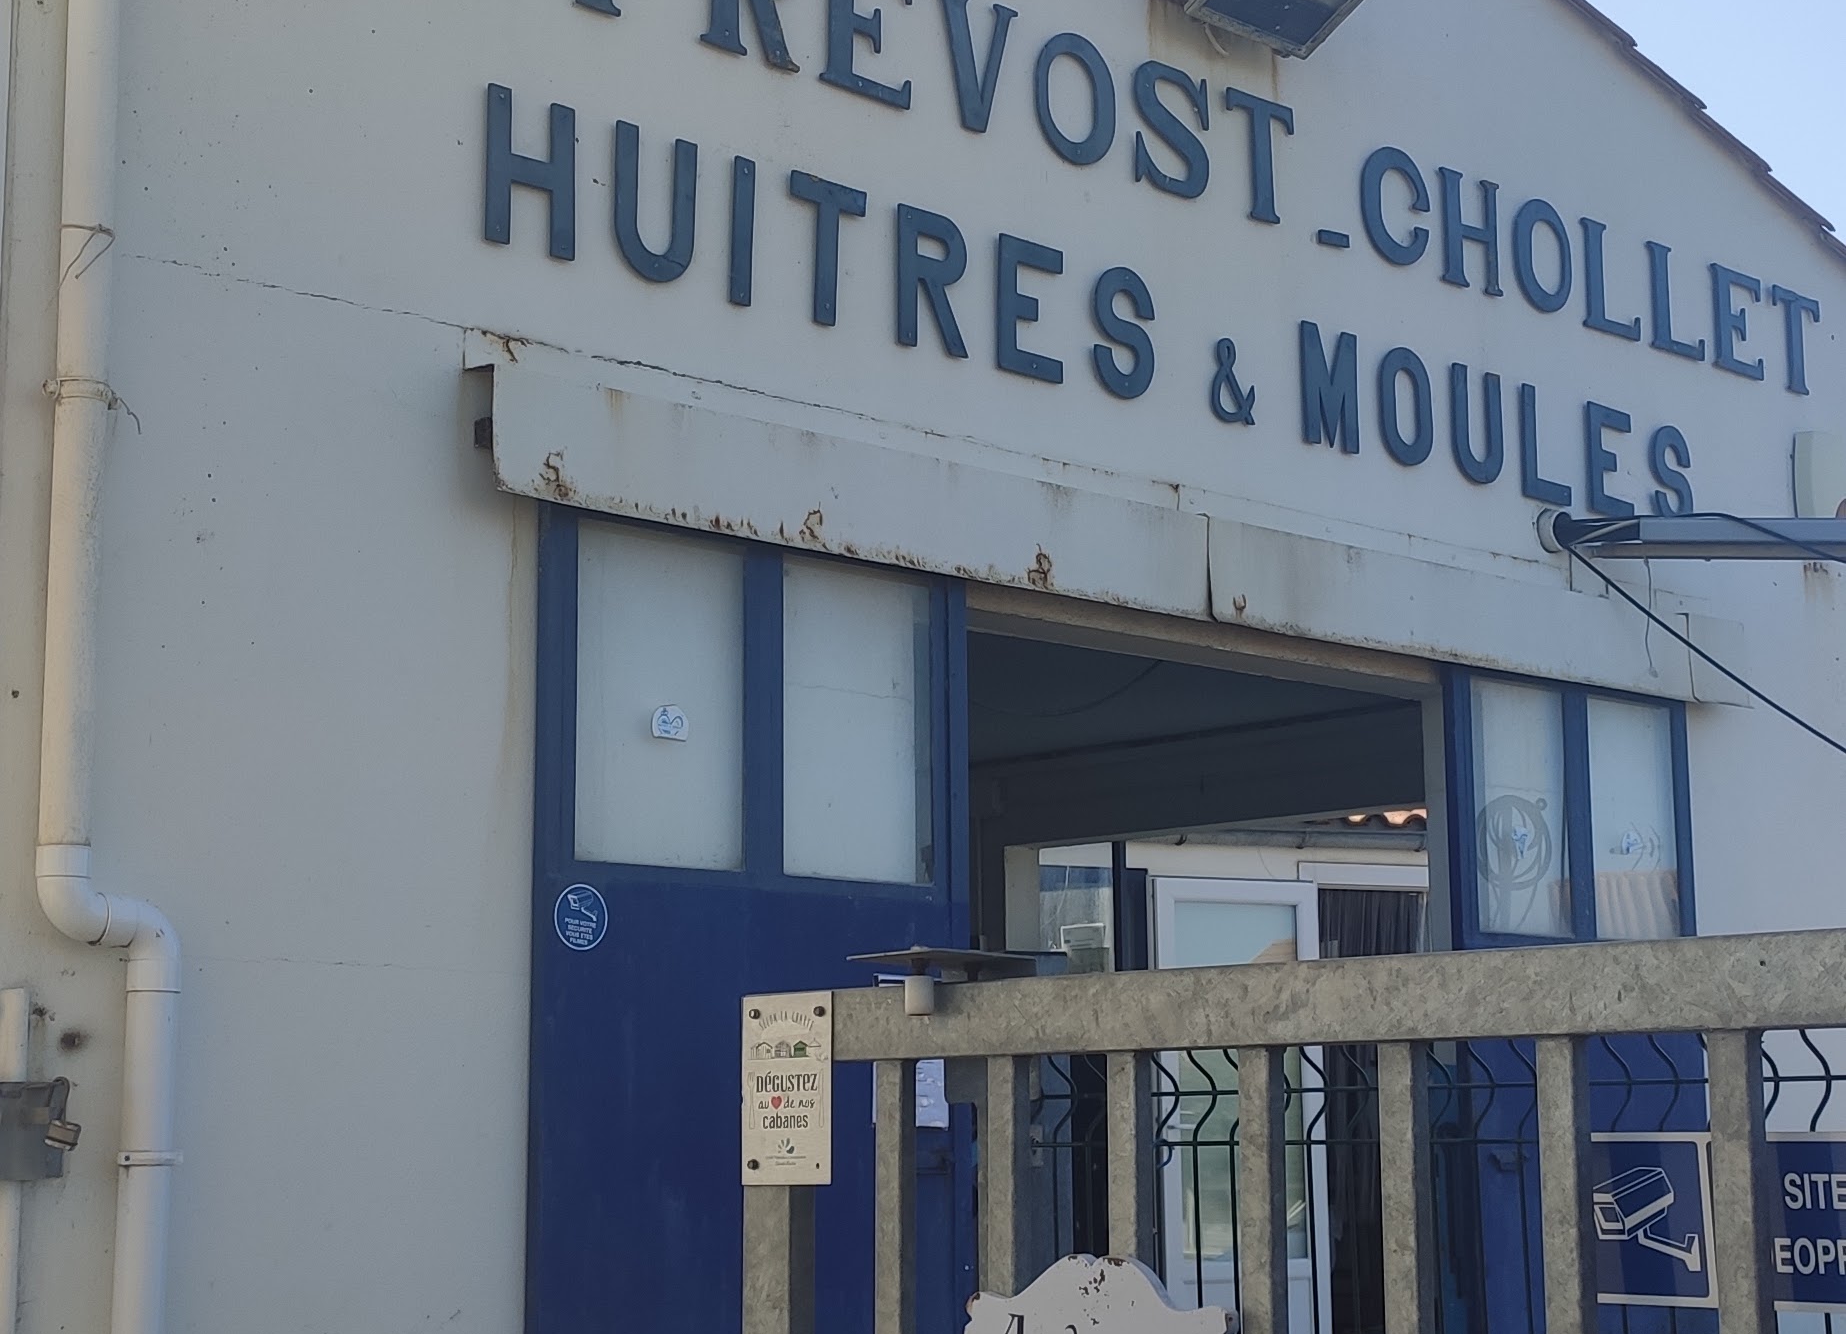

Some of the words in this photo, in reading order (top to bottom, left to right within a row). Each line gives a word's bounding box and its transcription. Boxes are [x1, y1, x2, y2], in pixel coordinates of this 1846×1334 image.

[483, 82, 1156, 401] HUITRES
[1209, 337, 1257, 426] &
[1300, 319, 1694, 517] MOULES
[758, 1100, 770, 1110] au
[783, 1095, 796, 1109] de
[798, 1098, 816, 1109] nos
[762, 1111, 809, 1129] cabanes
[1783, 1172, 1846, 1210] SITE
